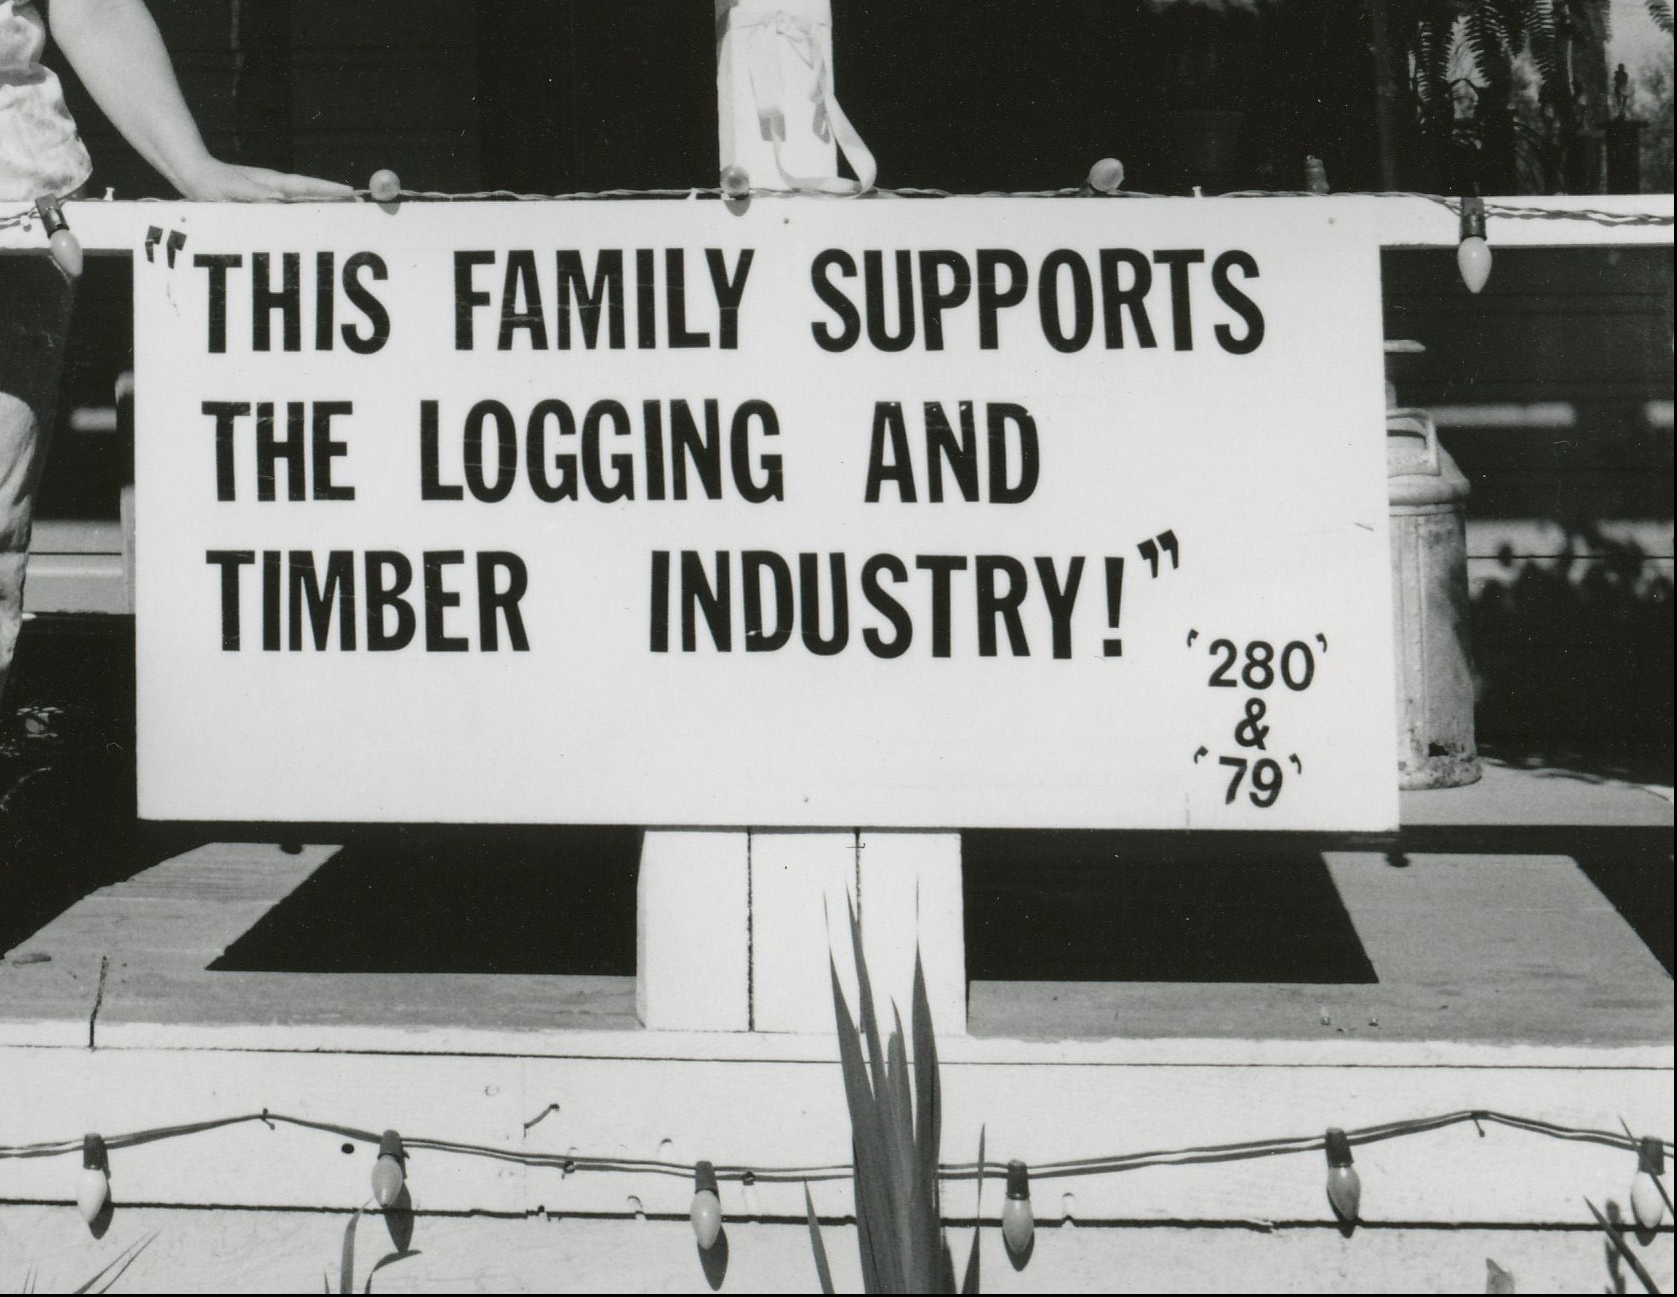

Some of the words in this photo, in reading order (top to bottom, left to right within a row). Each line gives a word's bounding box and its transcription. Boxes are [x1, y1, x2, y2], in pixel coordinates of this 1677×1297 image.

[453, 248, 756, 351] FAMILY
[810, 247, 1265, 355] SUPPORTS
[201, 401, 356, 502] THE
[420, 398, 784, 504] LOGGING
[864, 400, 1040, 505] AND
[205, 549, 530, 653] TIMBER
[1234, 697, 1270, 751] &
